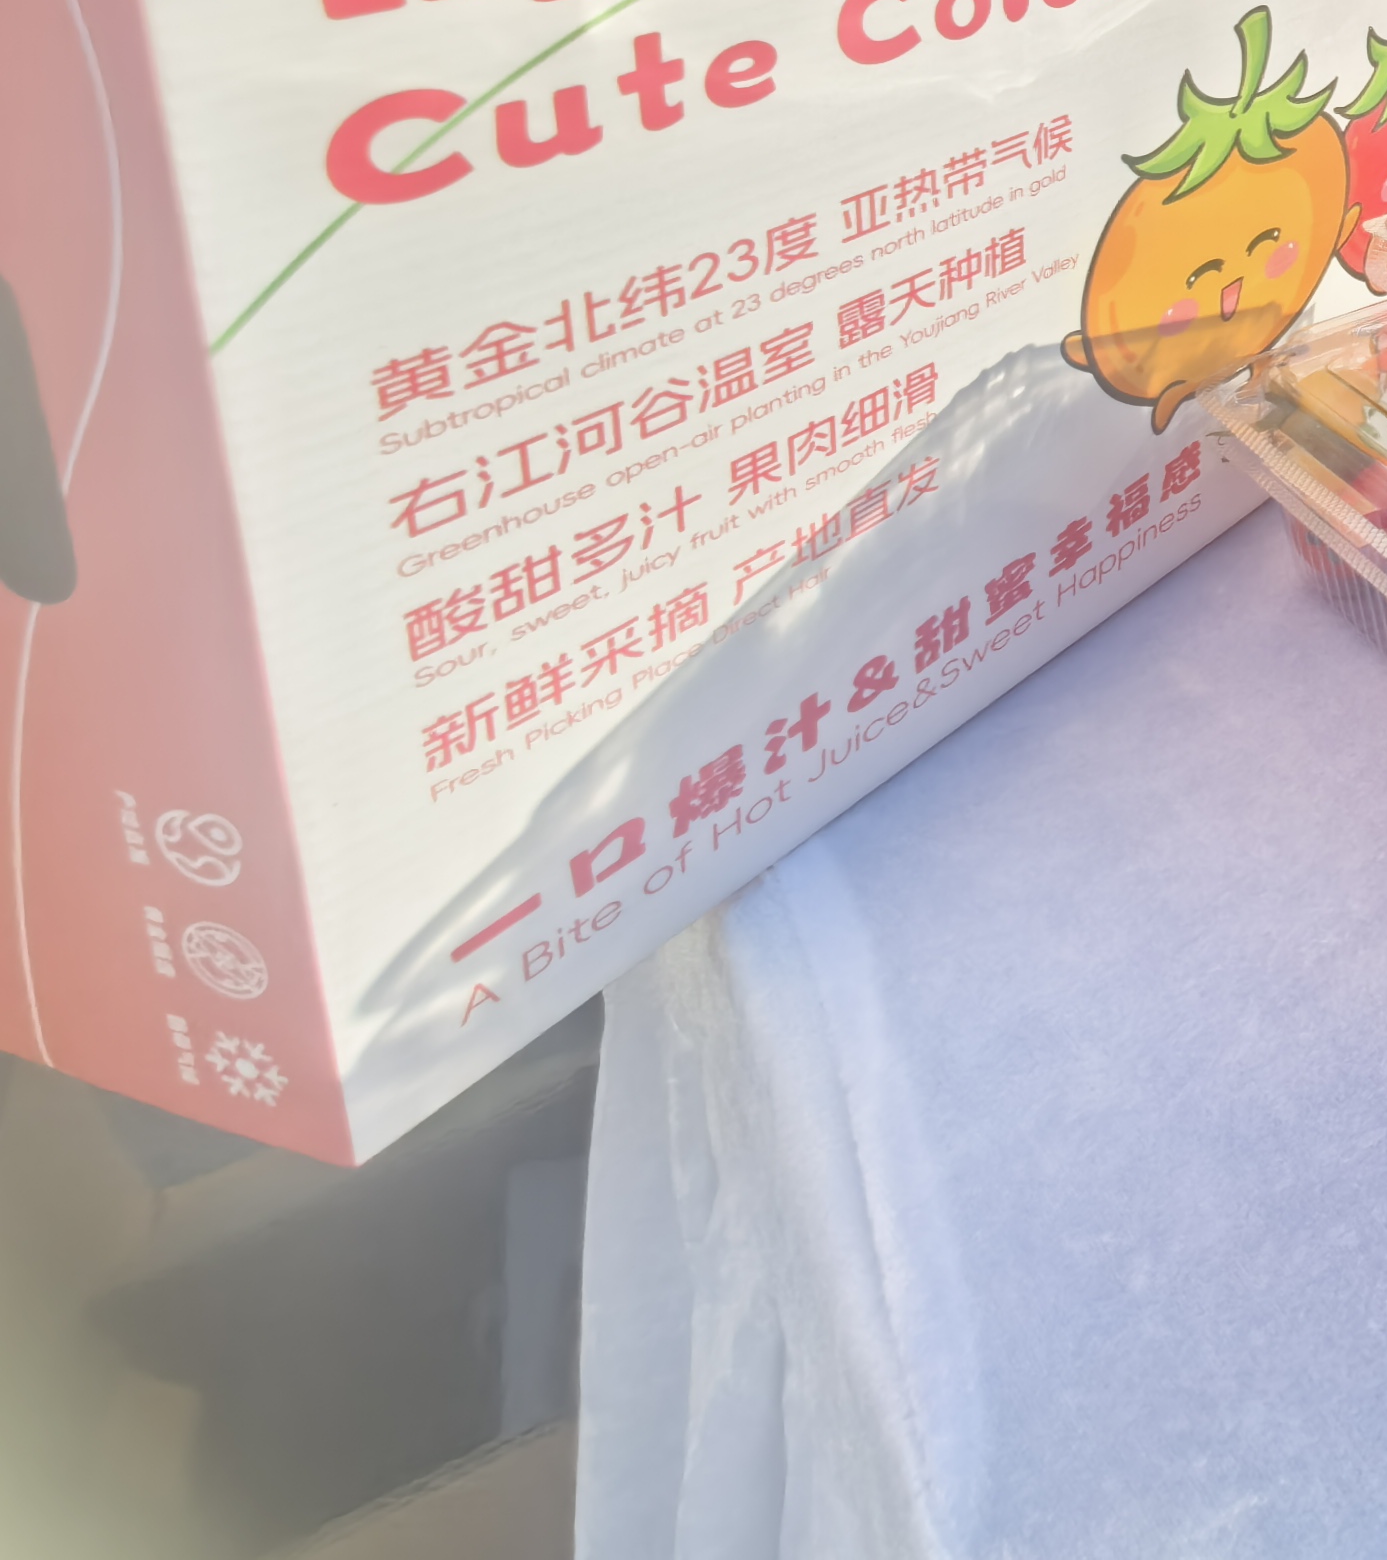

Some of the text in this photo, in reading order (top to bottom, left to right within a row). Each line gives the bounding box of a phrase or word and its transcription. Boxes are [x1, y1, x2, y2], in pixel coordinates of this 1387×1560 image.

[325, 32, 779, 205] Cute
[371, 114, 1074, 423] 黄金北纬23度 亚热带气候
[379, 164, 1068, 457] Subtropical climate at 23 degrees north latitude in gold
[387, 226, 1027, 540] 右江河谷温室 露天种植
[397, 251, 1081, 579] Greenhouse open-air planting in the Youjiang River Valley
[403, 361, 941, 663] 酸甜多汁 果肉细滑
[412, 409, 939, 689] Sour, sweet, juicy fruit with smooth flesh
[421, 455, 941, 773] 新鲜采摘 产地直发
[428, 565, 832, 803] Fresh Picking Place Direct Hair
[459, 982, 502, 1028] A
[520, 899, 623, 983] Bite
[711, 779, 792, 852] Hot
[807, 599, 1046, 783] Juice&Sweet
[1056, 492, 1203, 608] Happiness
